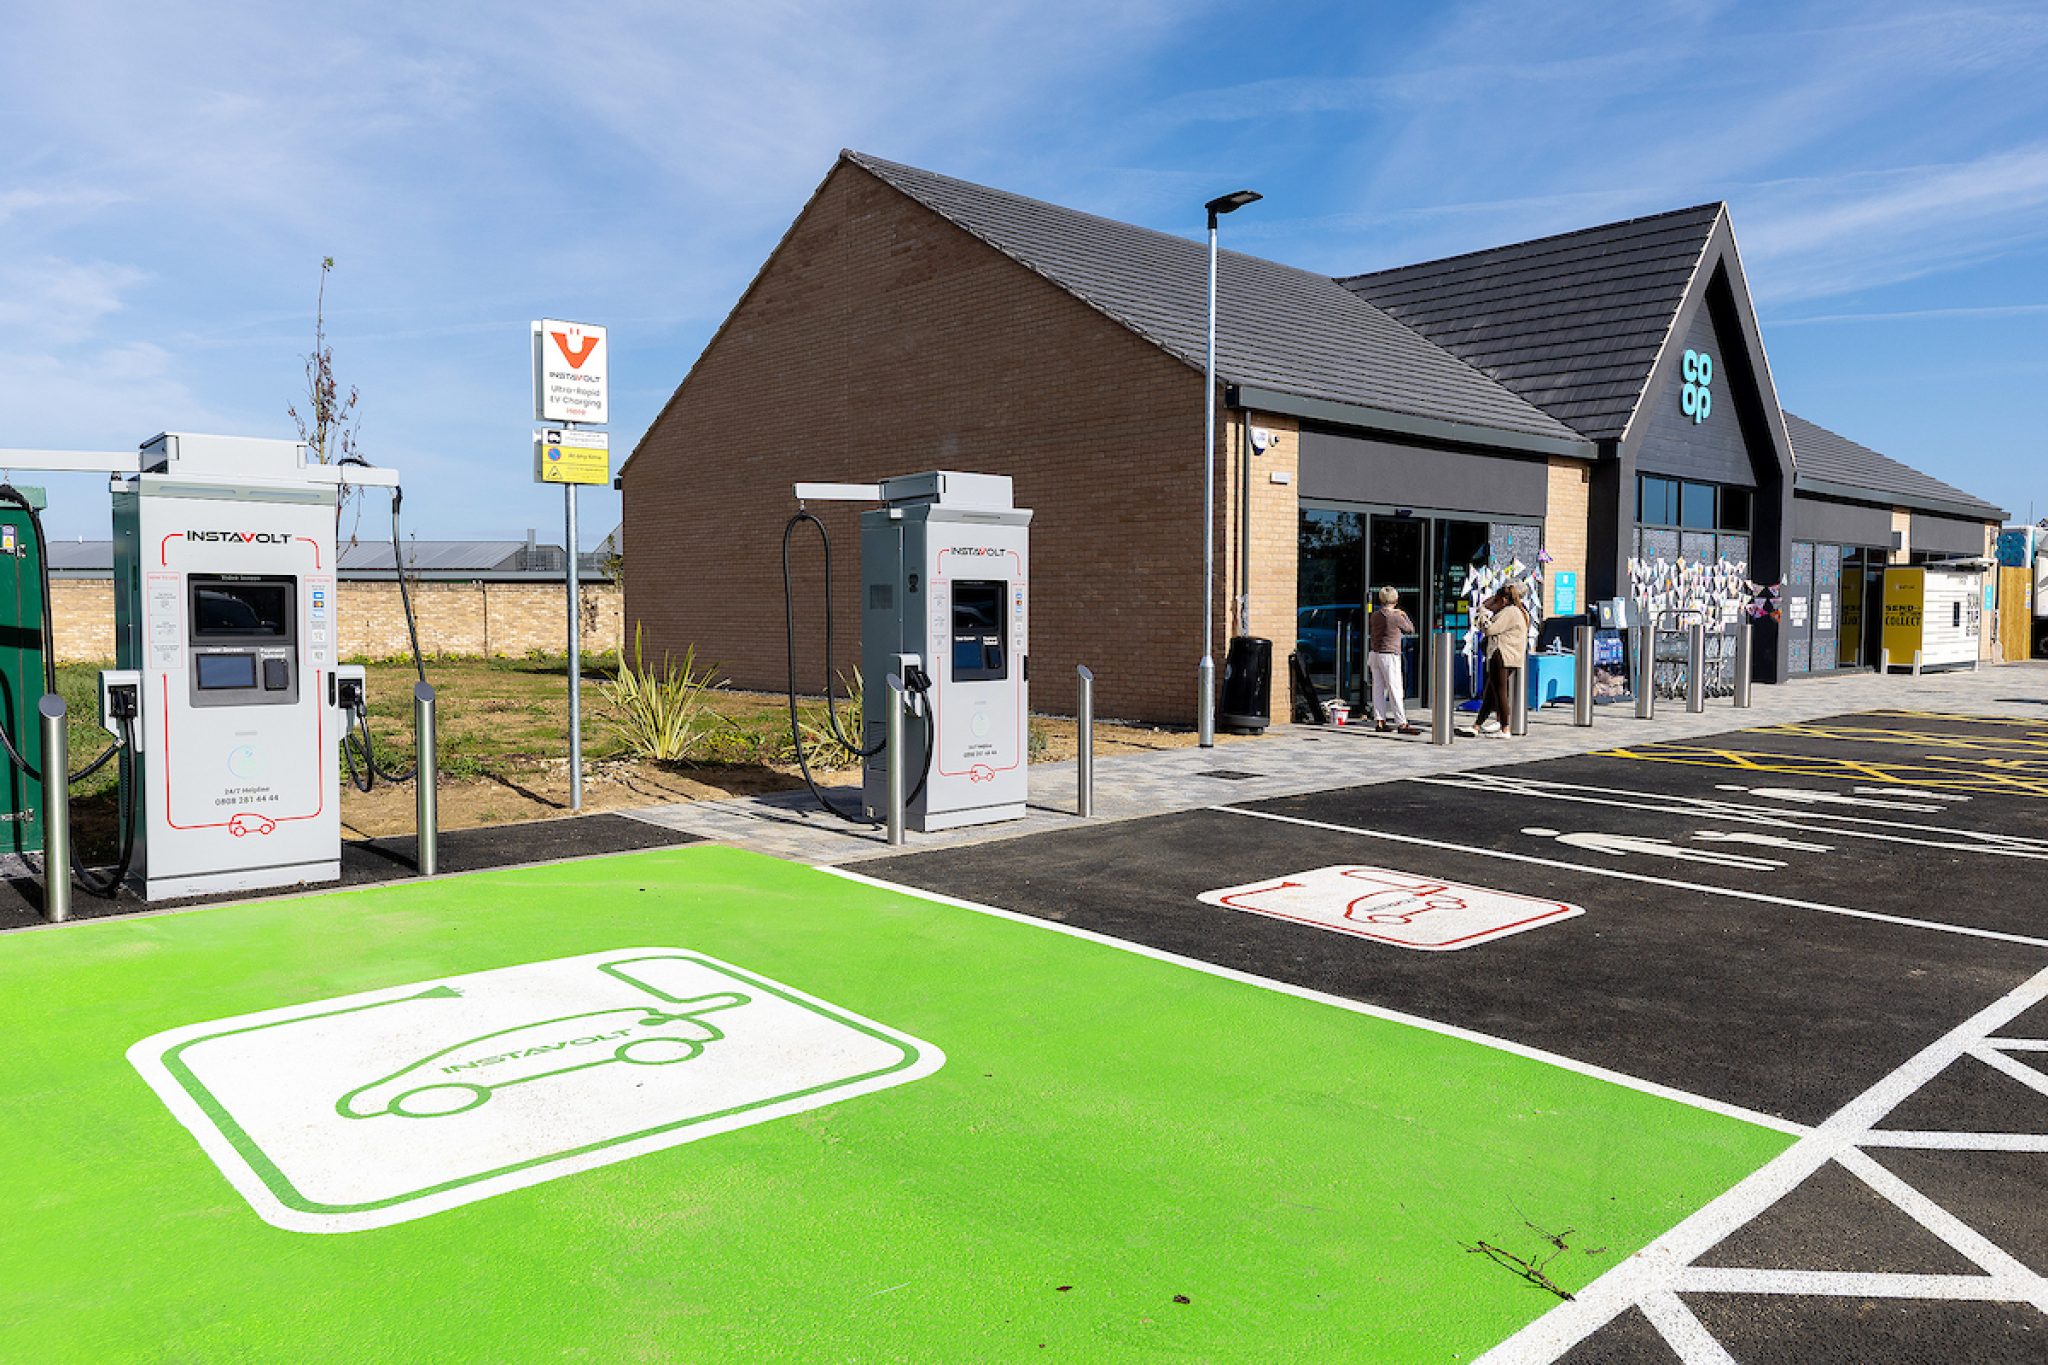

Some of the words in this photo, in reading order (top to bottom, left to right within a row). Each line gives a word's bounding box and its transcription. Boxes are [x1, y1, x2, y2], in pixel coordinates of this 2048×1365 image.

[549, 371, 601, 383] INSTAVOLT
[562, 396, 602, 409] Charging
[187, 530, 293, 544] INSTAVOLT
[950, 547, 1006, 557] INSTAVOLT
[440, 1029, 632, 1074] INSTAVOLT
